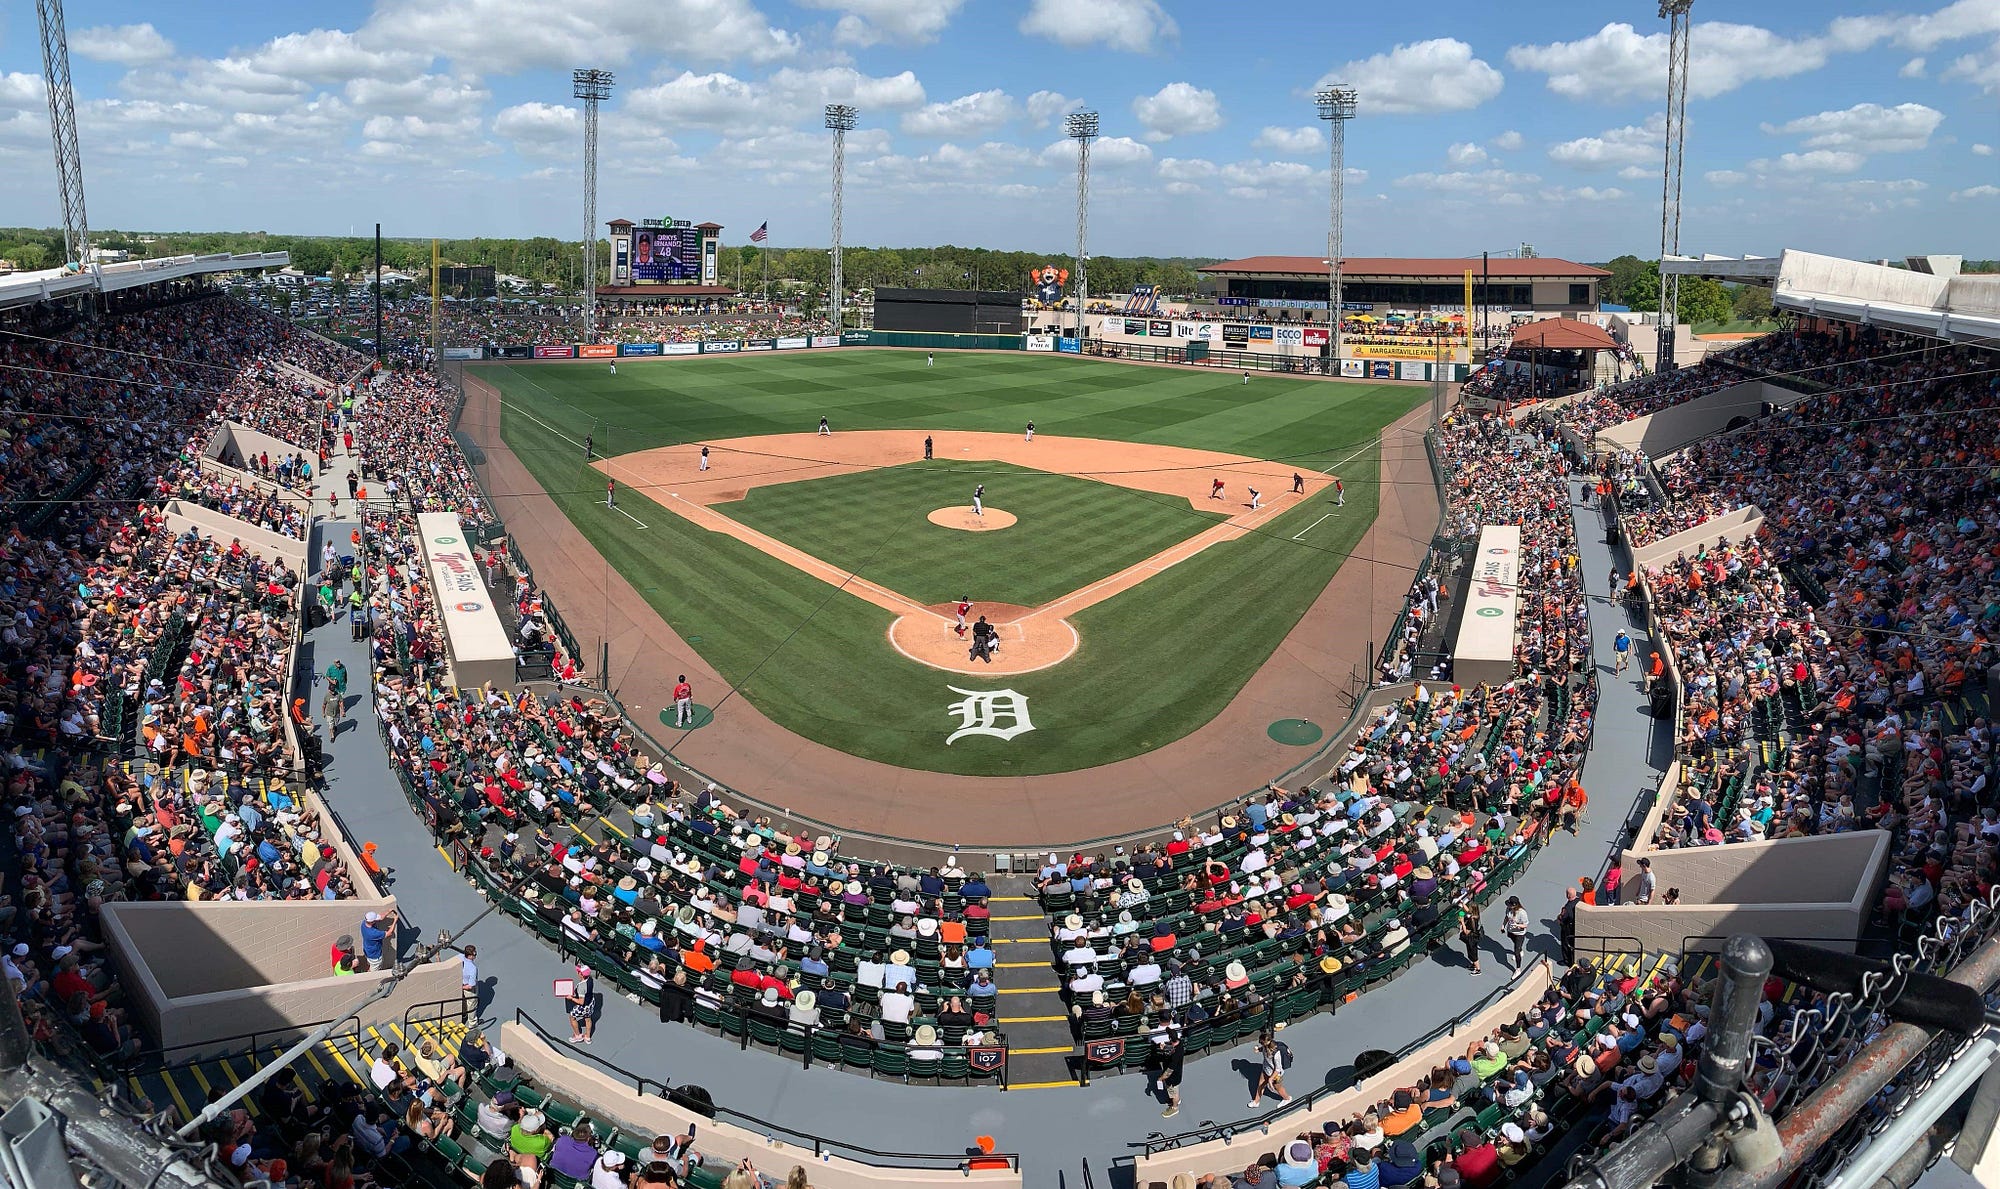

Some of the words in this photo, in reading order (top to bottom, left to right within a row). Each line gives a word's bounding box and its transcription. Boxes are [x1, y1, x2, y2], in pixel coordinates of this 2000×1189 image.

[660, 246, 671, 256] 48
[1177, 324, 1194, 337] Lite
[1277, 328, 1301, 340] ECCO
[1305, 335, 1327, 345] Wawa
[704, 342, 738, 351] GEICO
[1369, 347, 1420, 356] MARGARITAVILLE
[1484, 561, 1500, 576] FANS
[455, 573, 476, 592] FANS
[946, 684, 1036, 746] D
[1096, 1046, 1117, 1055] 106
